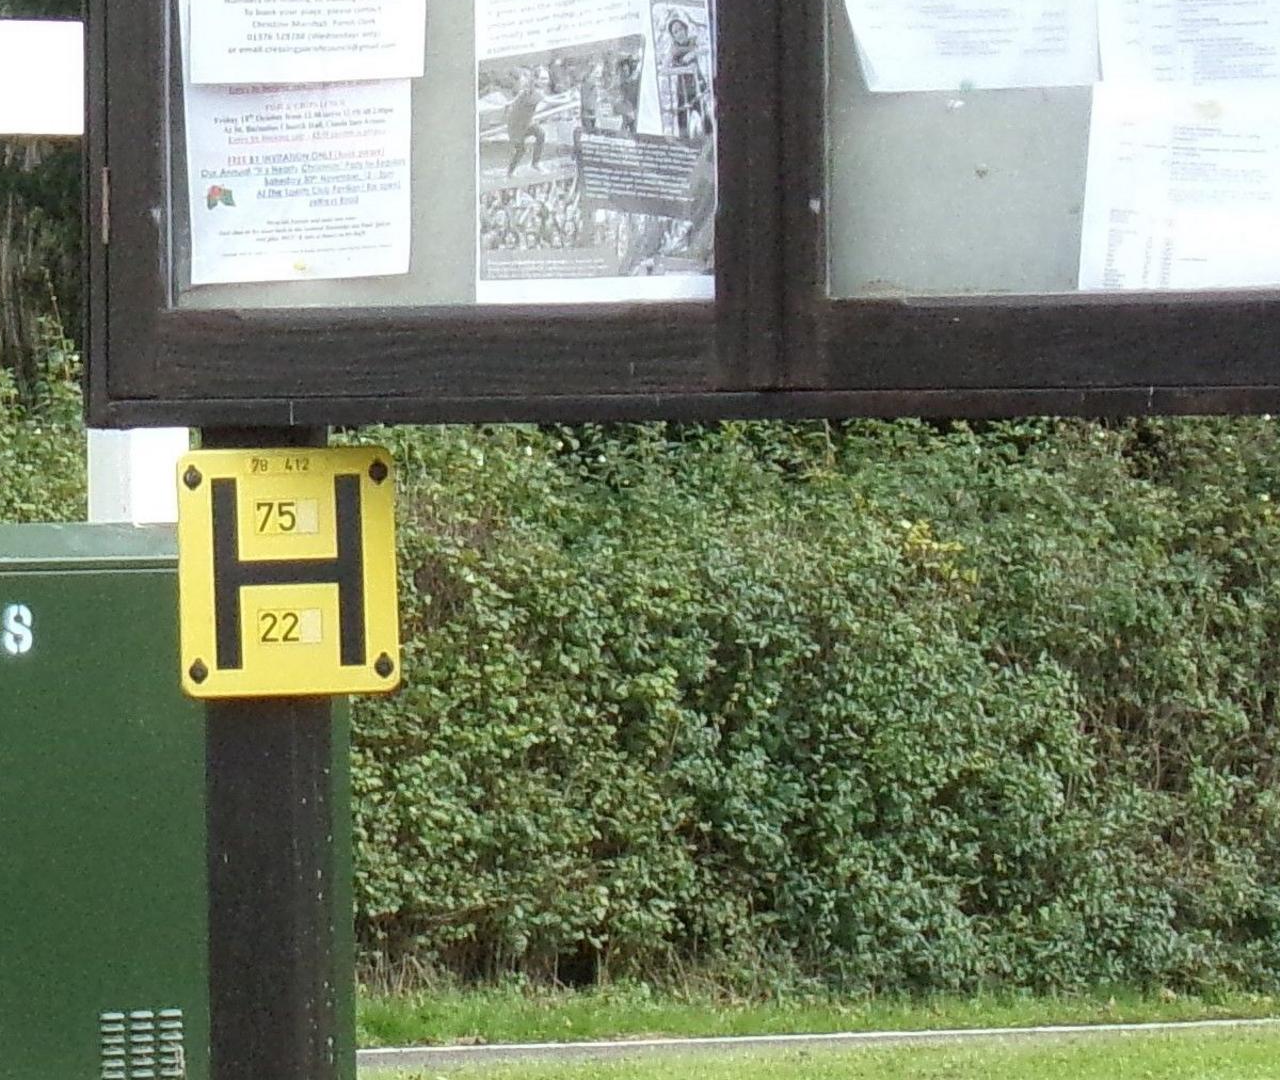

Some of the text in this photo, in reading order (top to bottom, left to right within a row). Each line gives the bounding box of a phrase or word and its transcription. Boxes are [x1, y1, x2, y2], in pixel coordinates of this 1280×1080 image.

[284, 457, 310, 471] 412
[256, 502, 296, 532] 75
[211, 473, 366, 670] H
[260, 612, 300, 643] 22
